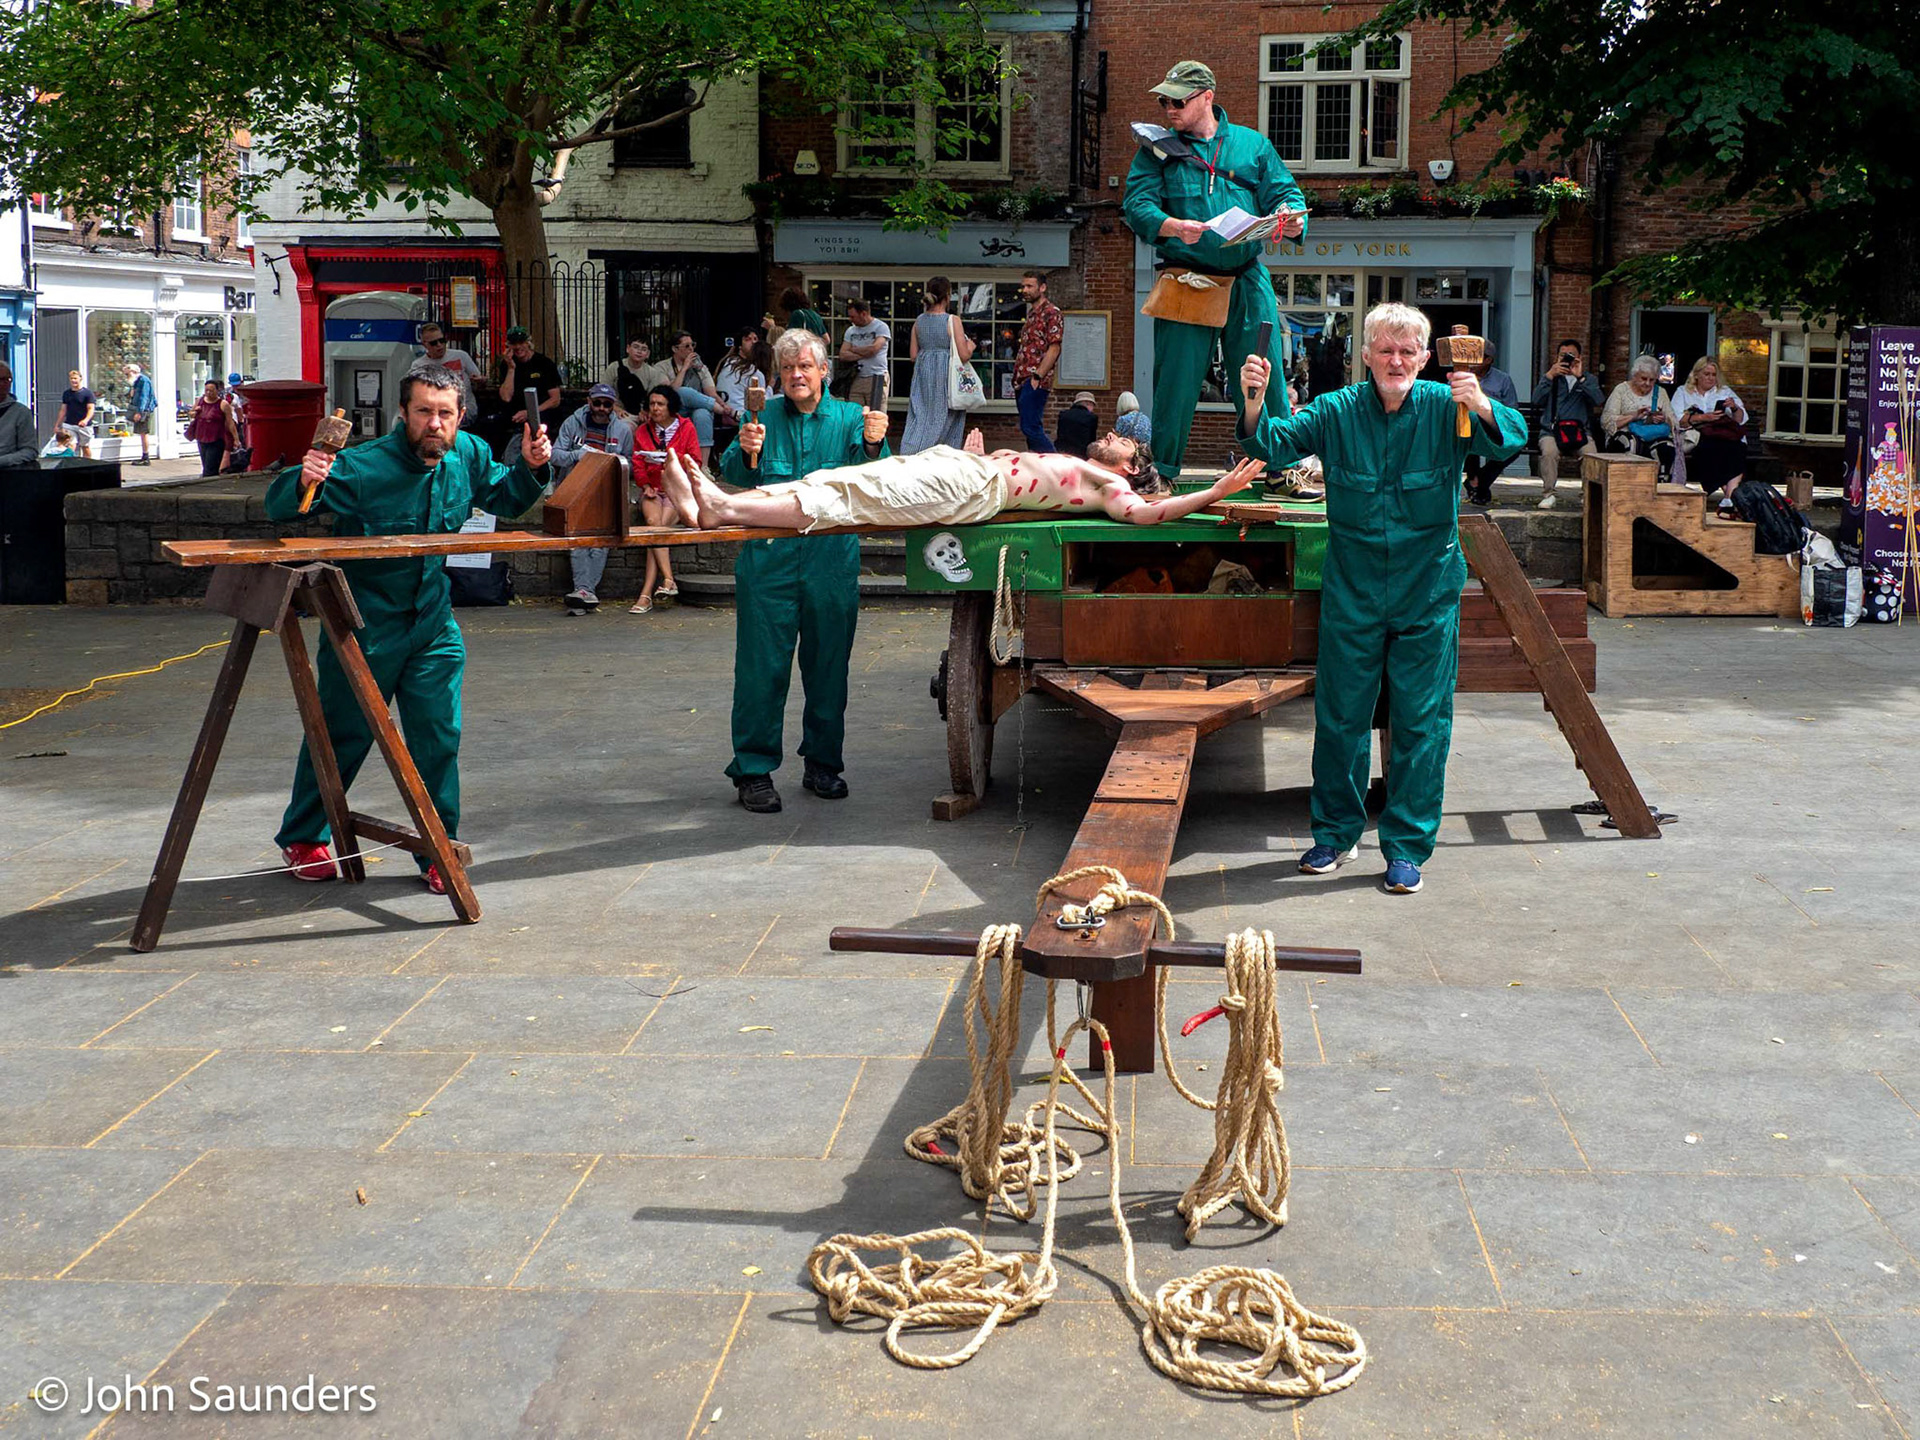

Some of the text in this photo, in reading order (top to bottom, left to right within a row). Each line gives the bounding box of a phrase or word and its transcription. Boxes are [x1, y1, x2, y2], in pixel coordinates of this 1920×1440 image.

[1264, 243, 1412, 256] UKE OF YORK
[1881, 340, 1915, 351] Leave
[1880, 368, 1897, 378] No
[1879, 381, 1901, 391] Jus
[1874, 549, 1909, 558] Choose
